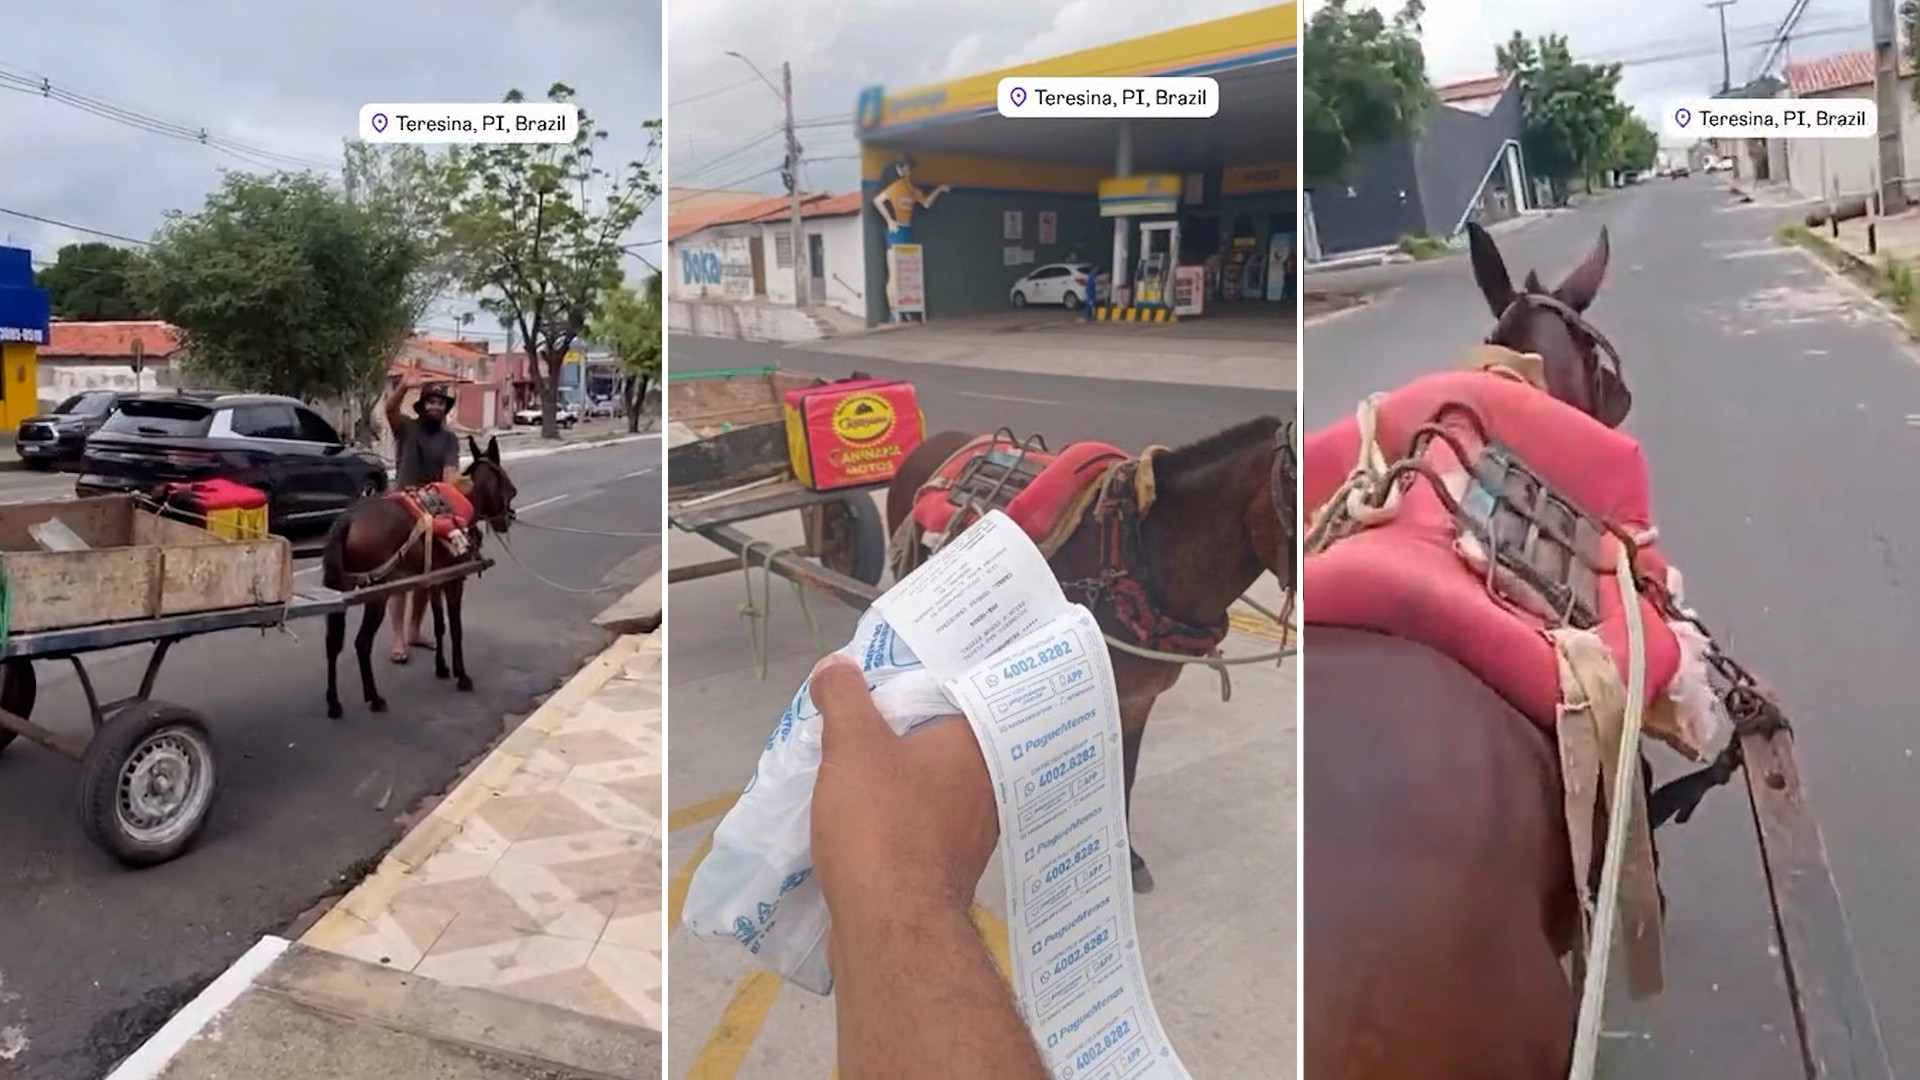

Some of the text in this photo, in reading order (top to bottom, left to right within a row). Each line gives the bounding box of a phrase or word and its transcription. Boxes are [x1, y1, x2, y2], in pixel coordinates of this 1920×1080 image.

[845, 460, 894, 476] MOTOS
[1003, 641, 1073, 679] 4002.8282
[1067, 669, 1083, 685] APP
[1039, 745, 1096, 787] 4002.8282
[1045, 839, 1101, 883] 4002.8282
[1054, 928, 1110, 974] 4002.8282
[1076, 1020, 1131, 1070] 4002.8282
[1127, 1047, 1141, 1063] APP
